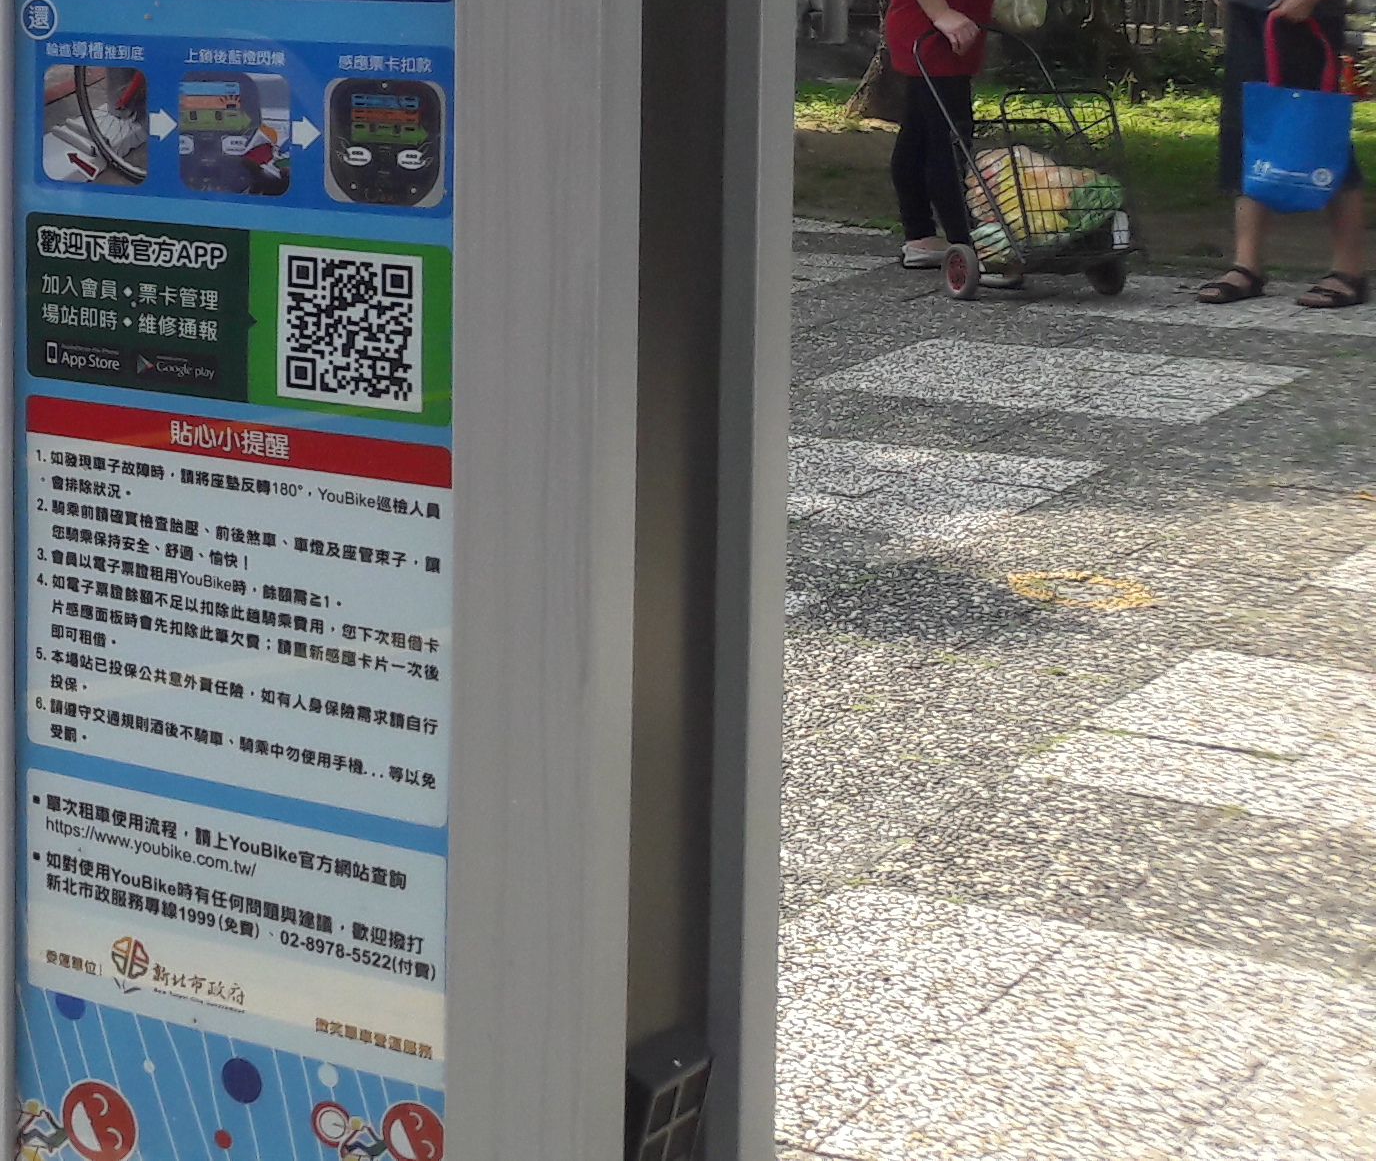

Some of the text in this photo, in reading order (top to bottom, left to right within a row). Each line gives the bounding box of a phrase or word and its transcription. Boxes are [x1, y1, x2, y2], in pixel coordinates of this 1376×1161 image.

[27, 5, 50, 30] 還
[37, 226, 227, 269] 歡迎下載官方APP
[41, 274, 219, 311] 加入會員 票卡管理
[41, 304, 218, 342] 場站即時 維修通報
[61, 351, 120, 371] App Store
[170, 420, 290, 459] 貼心小提醒
[45, 815, 257, 877] https://www.youbike.com.tw/
